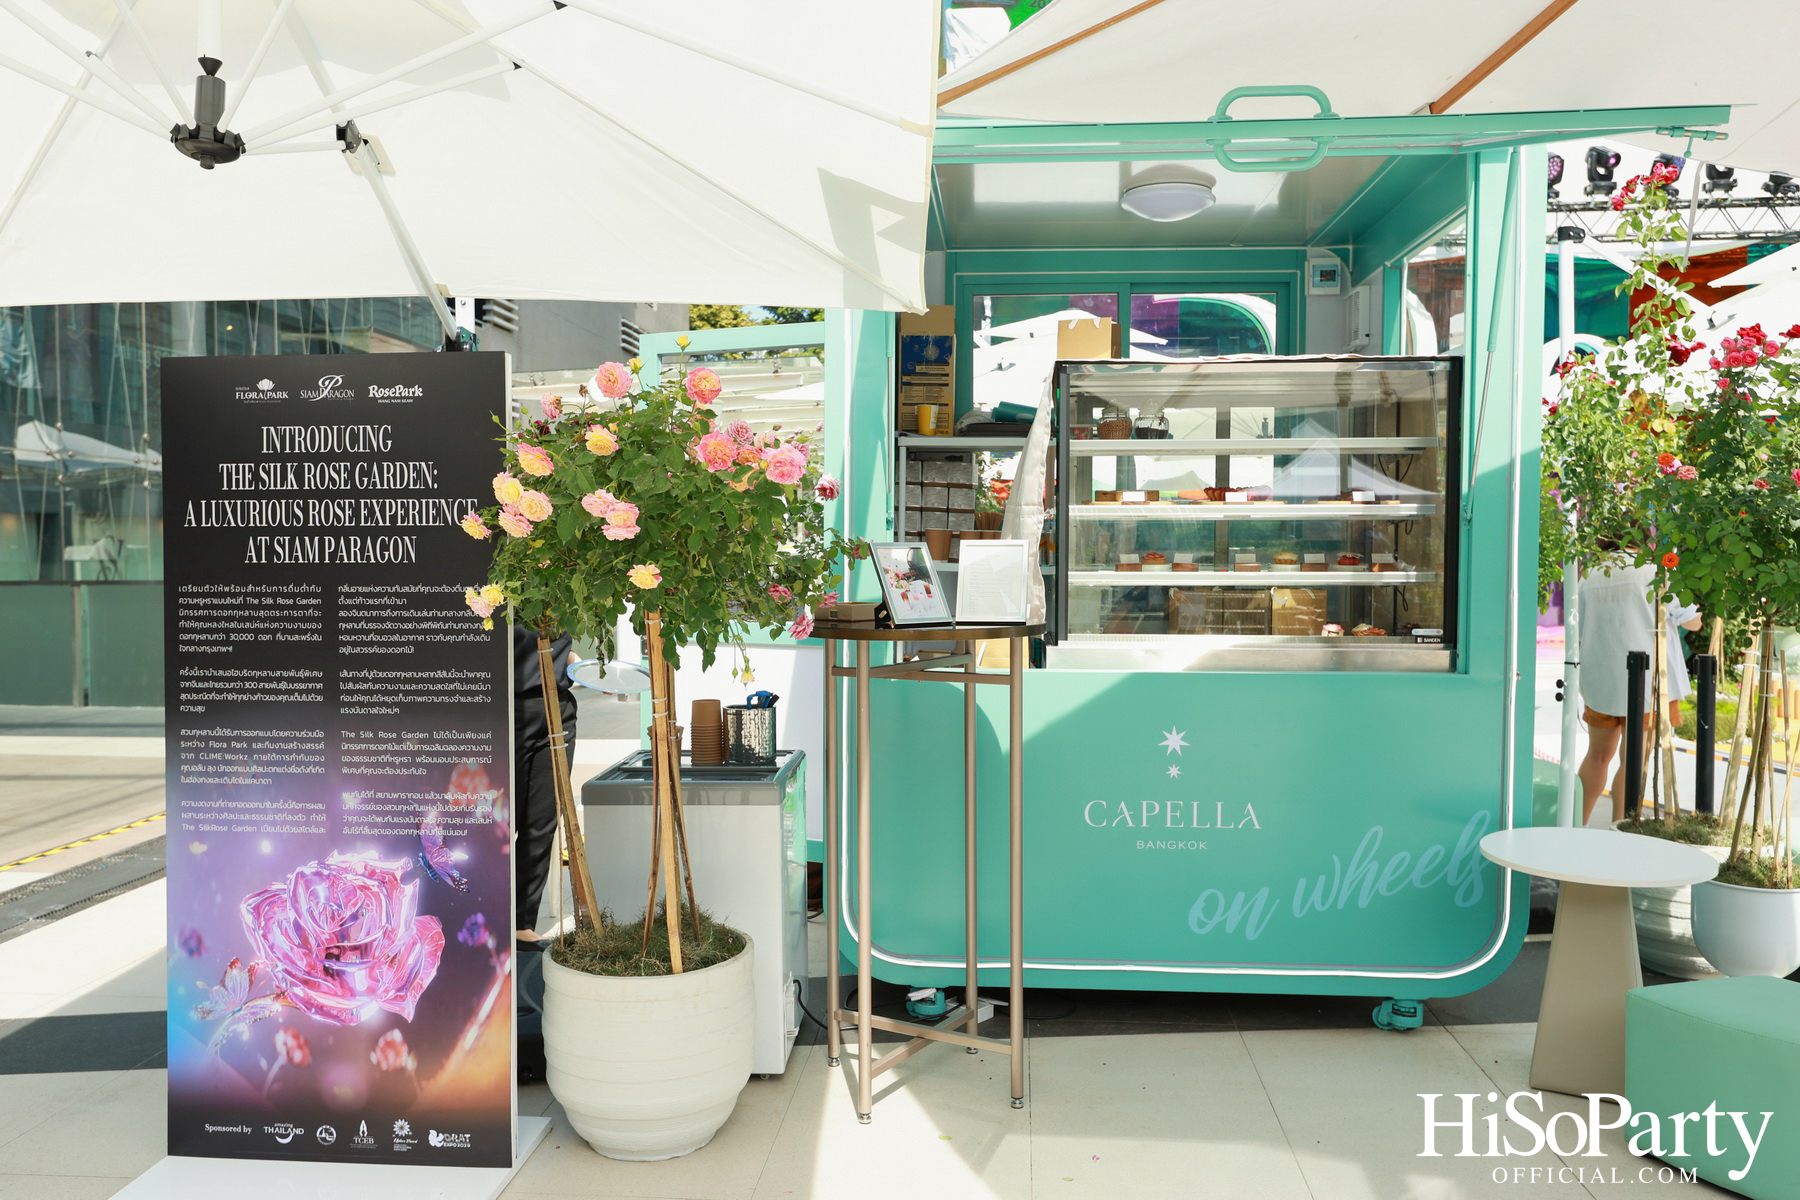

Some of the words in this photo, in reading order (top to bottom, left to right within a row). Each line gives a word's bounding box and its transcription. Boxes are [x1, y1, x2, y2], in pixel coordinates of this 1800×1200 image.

[236, 392, 264, 400] FLORA
[266, 391, 288, 399] PARK
[300, 390, 319, 398] SIAM
[368, 384, 424, 398] RosePark
[261, 424, 392, 453] INTRODUCING
[218, 463, 256, 490] THE
[258, 462, 300, 490] SILK
[303, 462, 351, 490] ROSE
[354, 461, 439, 490] GARDEN:
[184, 500, 198, 528] A
[200, 498, 304, 528] LUXURIOUS
[308, 498, 356, 527] ROSE
[359, 498, 478, 526] EXPERIENCE
[244, 536, 270, 564] AT
[273, 536, 320, 564] SIAM
[324, 536, 416, 564] PARAGON
[338, 595, 407, 605] ตั้งแต่ก้าวแรกที่เข้ามา
[179, 606, 322, 618] นิทรรศการดอกกุหลาบสุดตระการตาที่จะ
[179, 620, 322, 630] ทำให้คุณหลงใหลในเสน่ห์แห่งความงามของ
[179, 632, 226, 642] ดอกกุหลาบกว่า
[229, 633, 255, 642] 30,000
[339, 632, 425, 642] หอมหวานที่อบอวลในอากาศ
[426, 633, 491, 644] ราวกับคุณกำลังเดิน
[339, 644, 415, 656] อยู่ในสวรรค์ของดอกไม้!
[340, 681, 491, 691] ไปสัมผัสกับความงามและความสดใสที่ไม่เคยมีมา
[340, 693, 491, 704] ก่อนให้คุณได้หยุดเก็บภาพความทรงจำและสร้าง
[180, 705, 205, 714] ความสุข
[340, 706, 400, 715] แรงบันดาลใจใหม่ๆ
[342, 730, 355, 738] The
[359, 730, 374, 738] Silk
[402, 730, 429, 738] Garden
[180, 740, 205, 748] ระหว่าง
[252, 740, 324, 750] และทีมงานสร้างสรรค์
[200, 752, 248, 760] CLIME:Workz
[253, 752, 325, 762] ภายใต้การกำกับของ
[342, 754, 411, 764] ของธรรมชาติที่หรูหรา
[342, 766, 427, 776] พิเศษที่คุณจะต้องประทับใจ
[376, 790, 424, 799] สยามพารากอน
[1084, 800, 1262, 830] CAPELLA
[437, 816, 463, 826] ความสุข
[1136, 840, 1207, 850] BANGKOK
[1188, 886, 1280, 941] on
[1292, 810, 1492, 918] wheels
[204, 1124, 242, 1133] Sponsored
[243, 1124, 252, 1134] by
[264, 1126, 304, 1135] THAILAND
